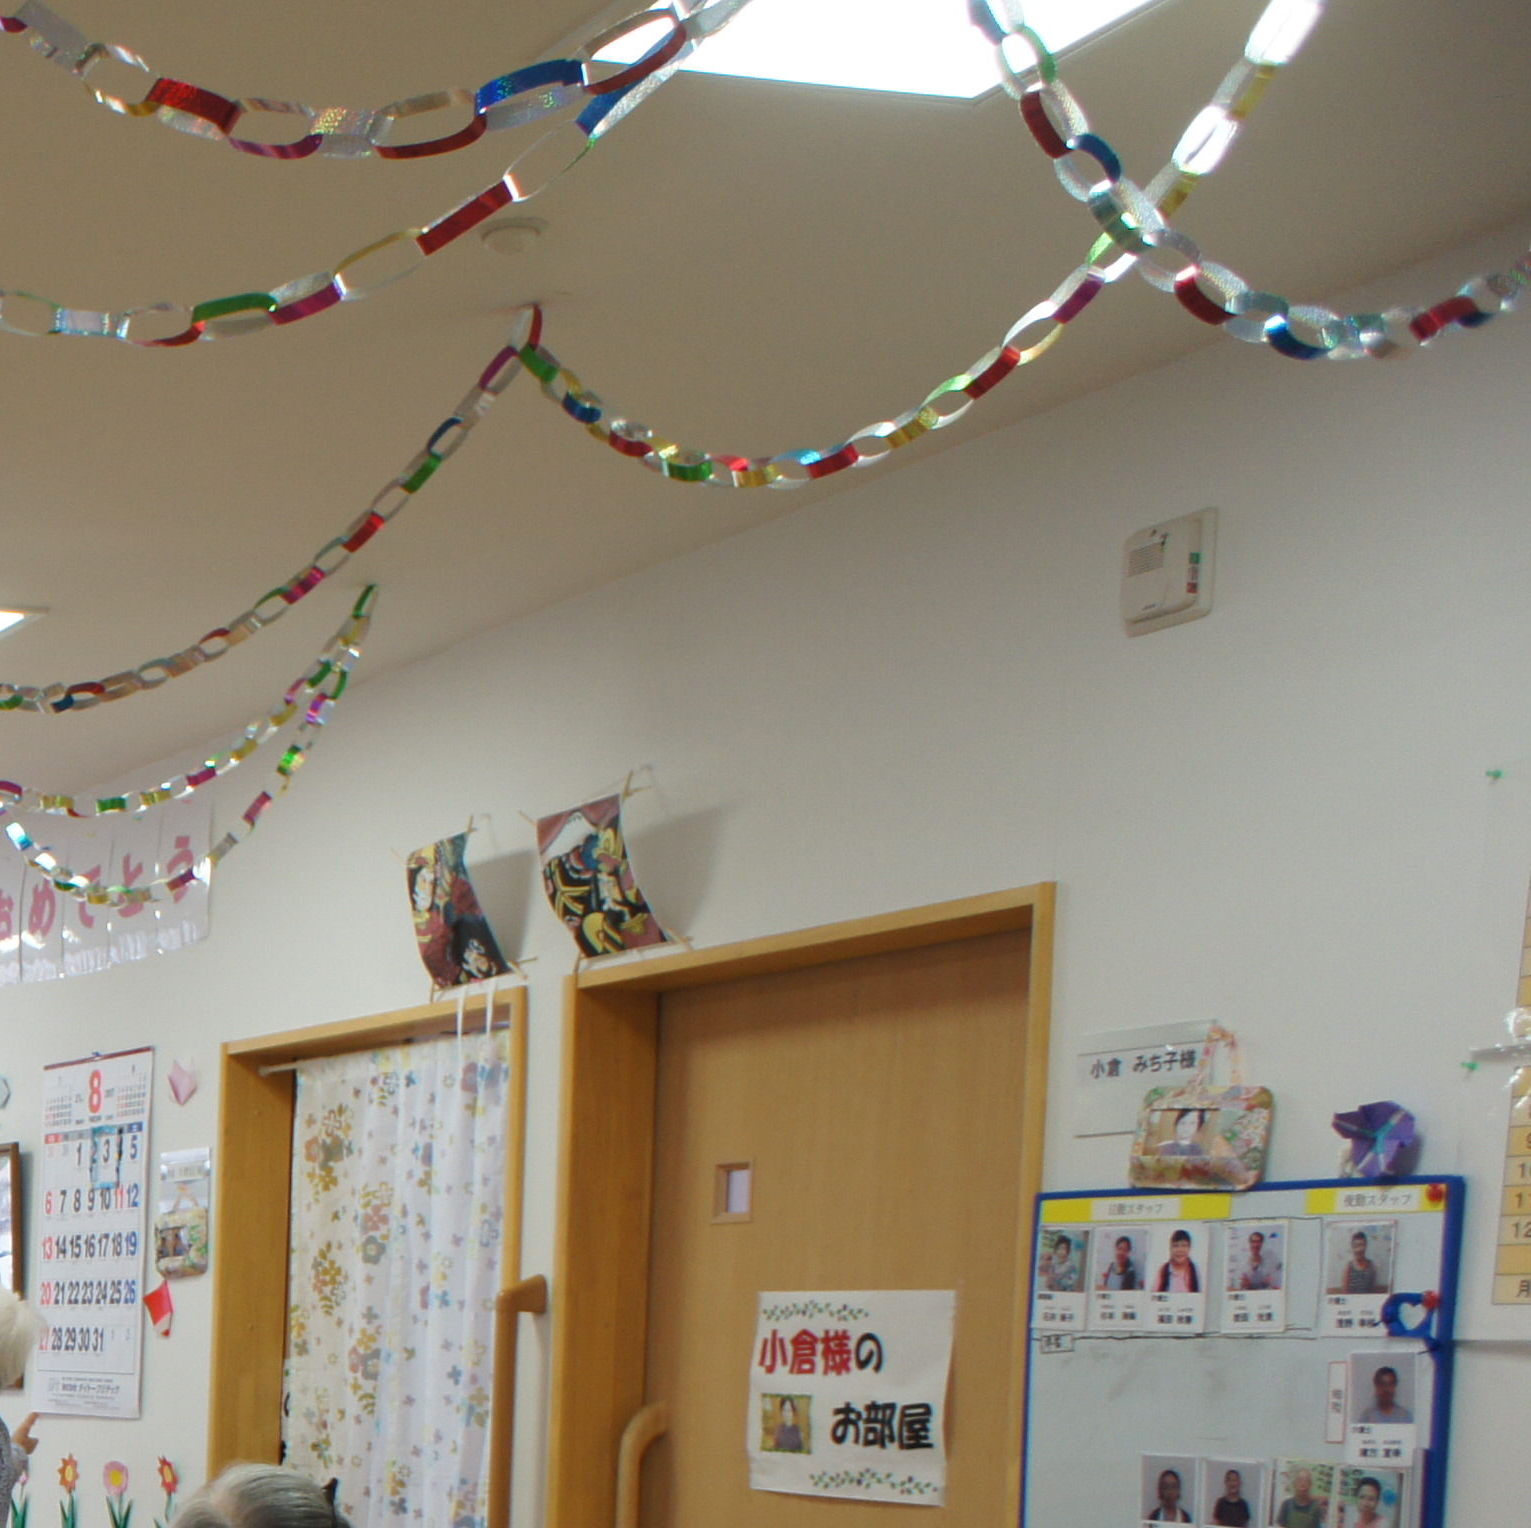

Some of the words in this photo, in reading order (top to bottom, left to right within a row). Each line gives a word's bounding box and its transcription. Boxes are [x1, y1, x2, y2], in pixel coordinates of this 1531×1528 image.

[1090, 1058, 1122, 1079] 小倉
[89, 1070, 102, 1114] 8
[77, 1142, 82, 1166] 1
[103, 1138, 111, 1163] 3
[130, 1135, 138, 1160] 5
[45, 1191, 53, 1214] 6
[60, 1189, 67, 1213] 7
[73, 1188, 81, 1212] 8
[87, 1187, 95, 1211] 9
[100, 1186, 111, 1210] 10
[114, 1187, 124, 1209] 11
[127, 1183, 139, 1207] 12
[43, 1236, 53, 1260] 13
[56, 1235, 67, 1259] 14
[70, 1235, 81, 1258] 15
[85, 1234, 95, 1258] 16
[98, 1233, 109, 1257] 17
[112, 1232, 122, 1256] 18
[126, 1231, 137, 1256] 19
[40, 1282, 51, 1305] 20
[54, 1281, 65, 1305] 21
[67, 1281, 79, 1305] 22
[81, 1281, 93, 1305] 23
[95, 1281, 107, 1305] 24
[109, 1280, 121, 1305] 25
[124, 1280, 136, 1304] 26
[52, 1327, 62, 1350] 28
[64, 1327, 76, 1351] 29
[78, 1327, 90, 1351] 30
[92, 1327, 104, 1352] 31
[758, 1328, 884, 1376] 小倉様の
[830, 1401, 934, 1450] お部屋
